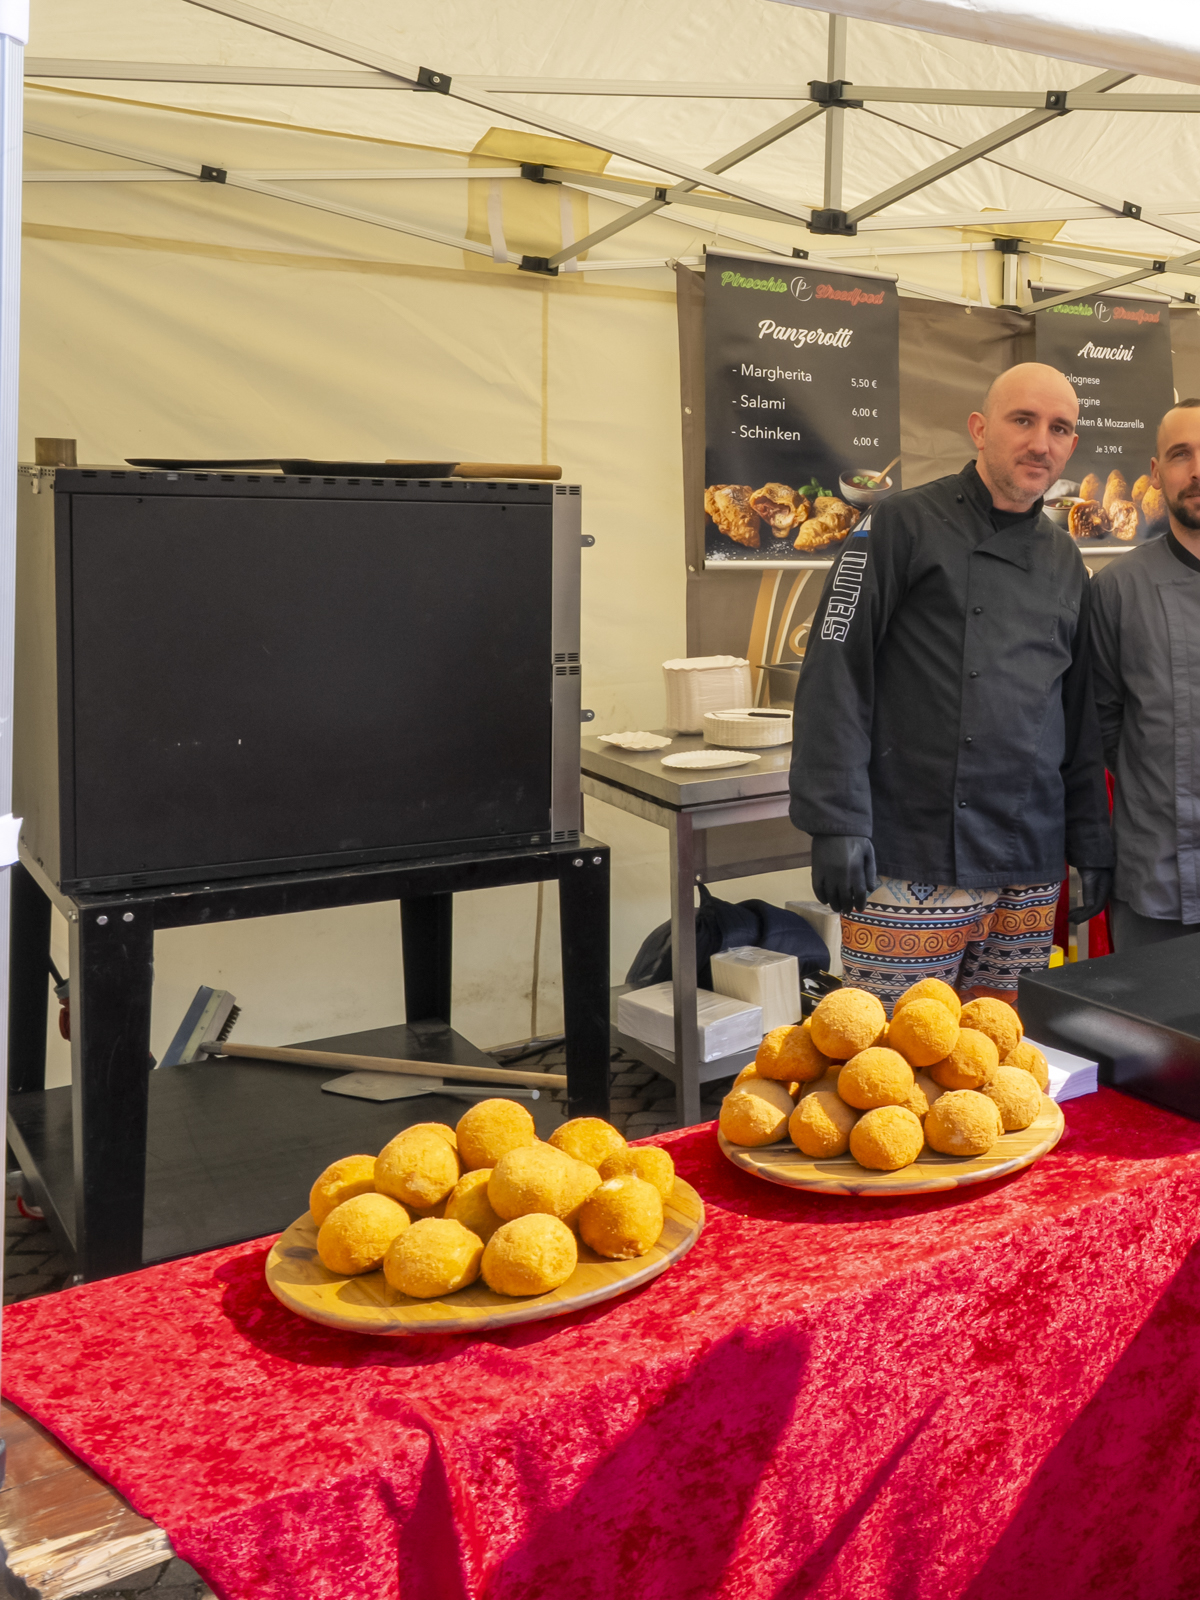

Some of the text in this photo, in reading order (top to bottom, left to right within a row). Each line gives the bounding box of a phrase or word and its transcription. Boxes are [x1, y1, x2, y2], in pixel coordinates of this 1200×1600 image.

[721, 271, 788, 293] Pinocchio
[1046, 303, 1093, 316] inocchio
[758, 319, 853, 349] Panzerotti
[1077, 341, 1135, 361] Arancini
[741, 363, 812, 382] Margherita
[851, 378, 878, 389] 5,50 €
[1063, 373, 1101, 386] olognese
[740, 394, 786, 410] Salami
[1077, 396, 1101, 408] ergine
[851, 408, 878, 418] 6,00 €
[1077, 416, 1145, 429] nken & Mozzarella
[739, 425, 801, 441] Schinken
[853, 437, 879, 447] 6,00 €
[1095, 445, 1123, 454] Je 3,90 €
